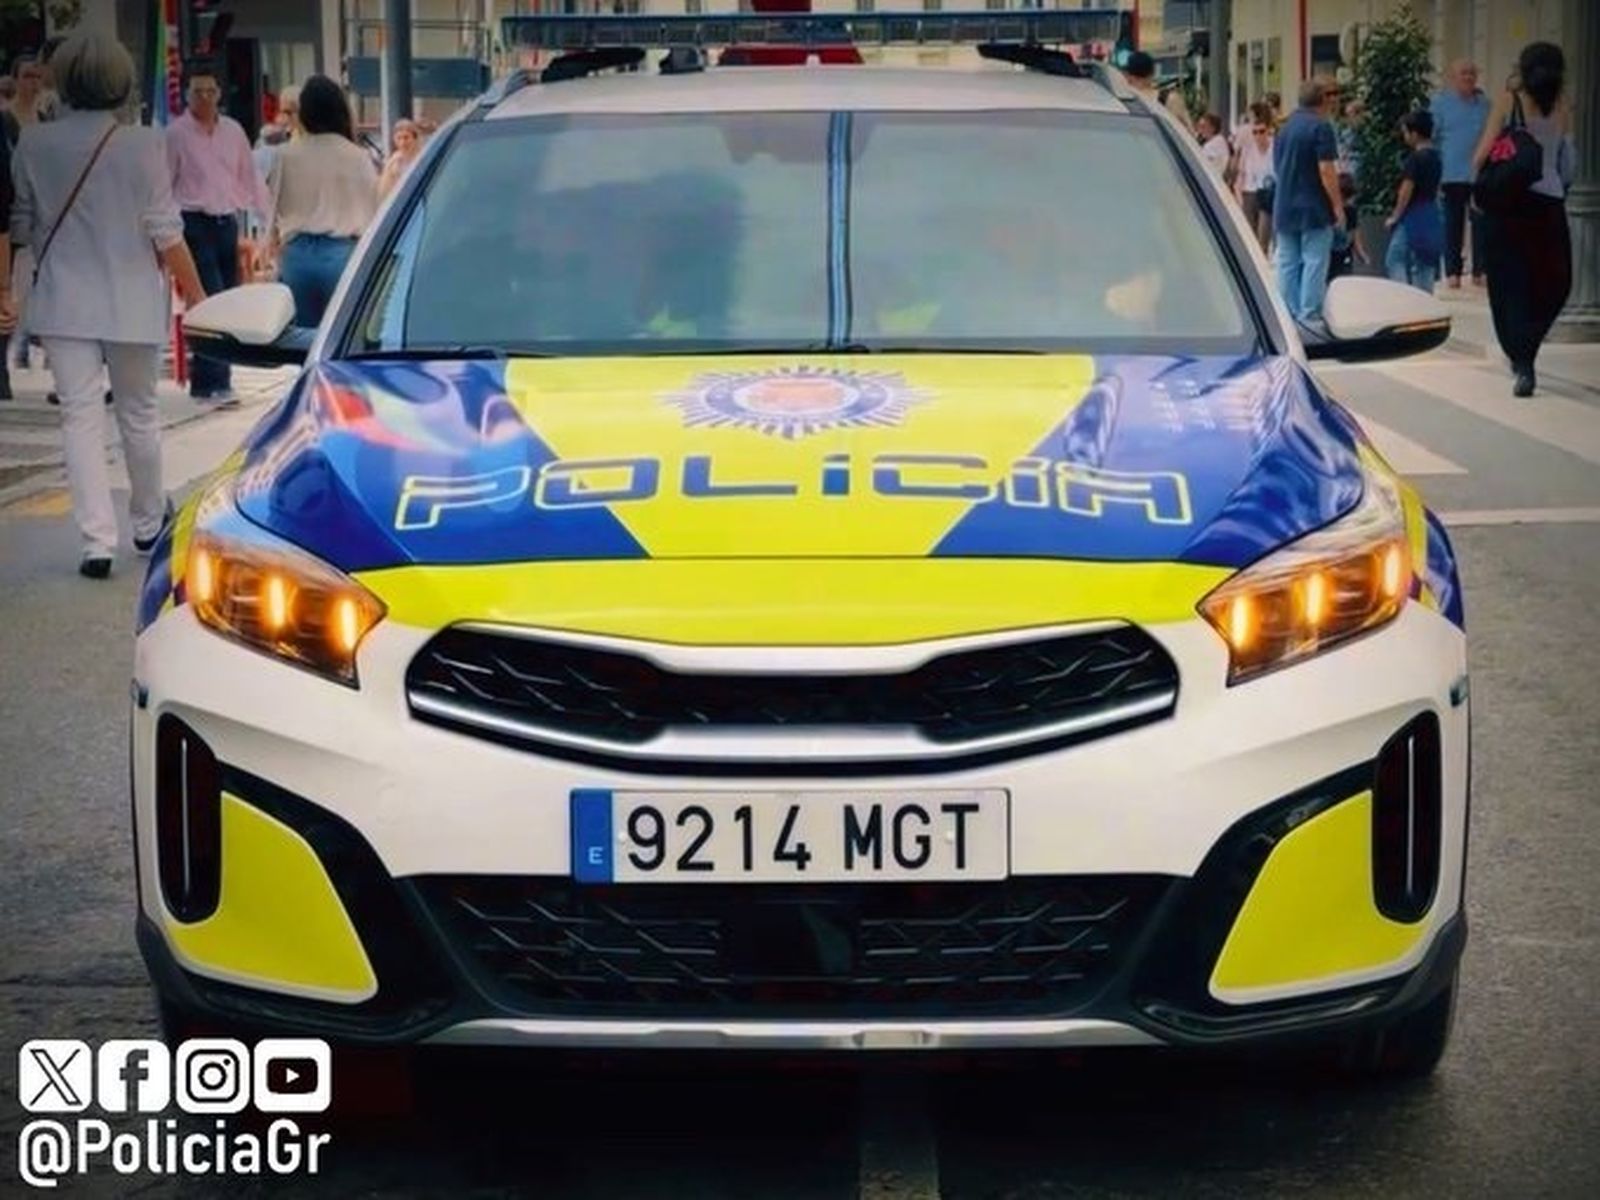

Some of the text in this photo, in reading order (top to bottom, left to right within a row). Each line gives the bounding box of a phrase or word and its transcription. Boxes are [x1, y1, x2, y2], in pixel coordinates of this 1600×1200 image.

[588, 846, 604, 865] E
[627, 803, 980, 872] 9214 MGT
